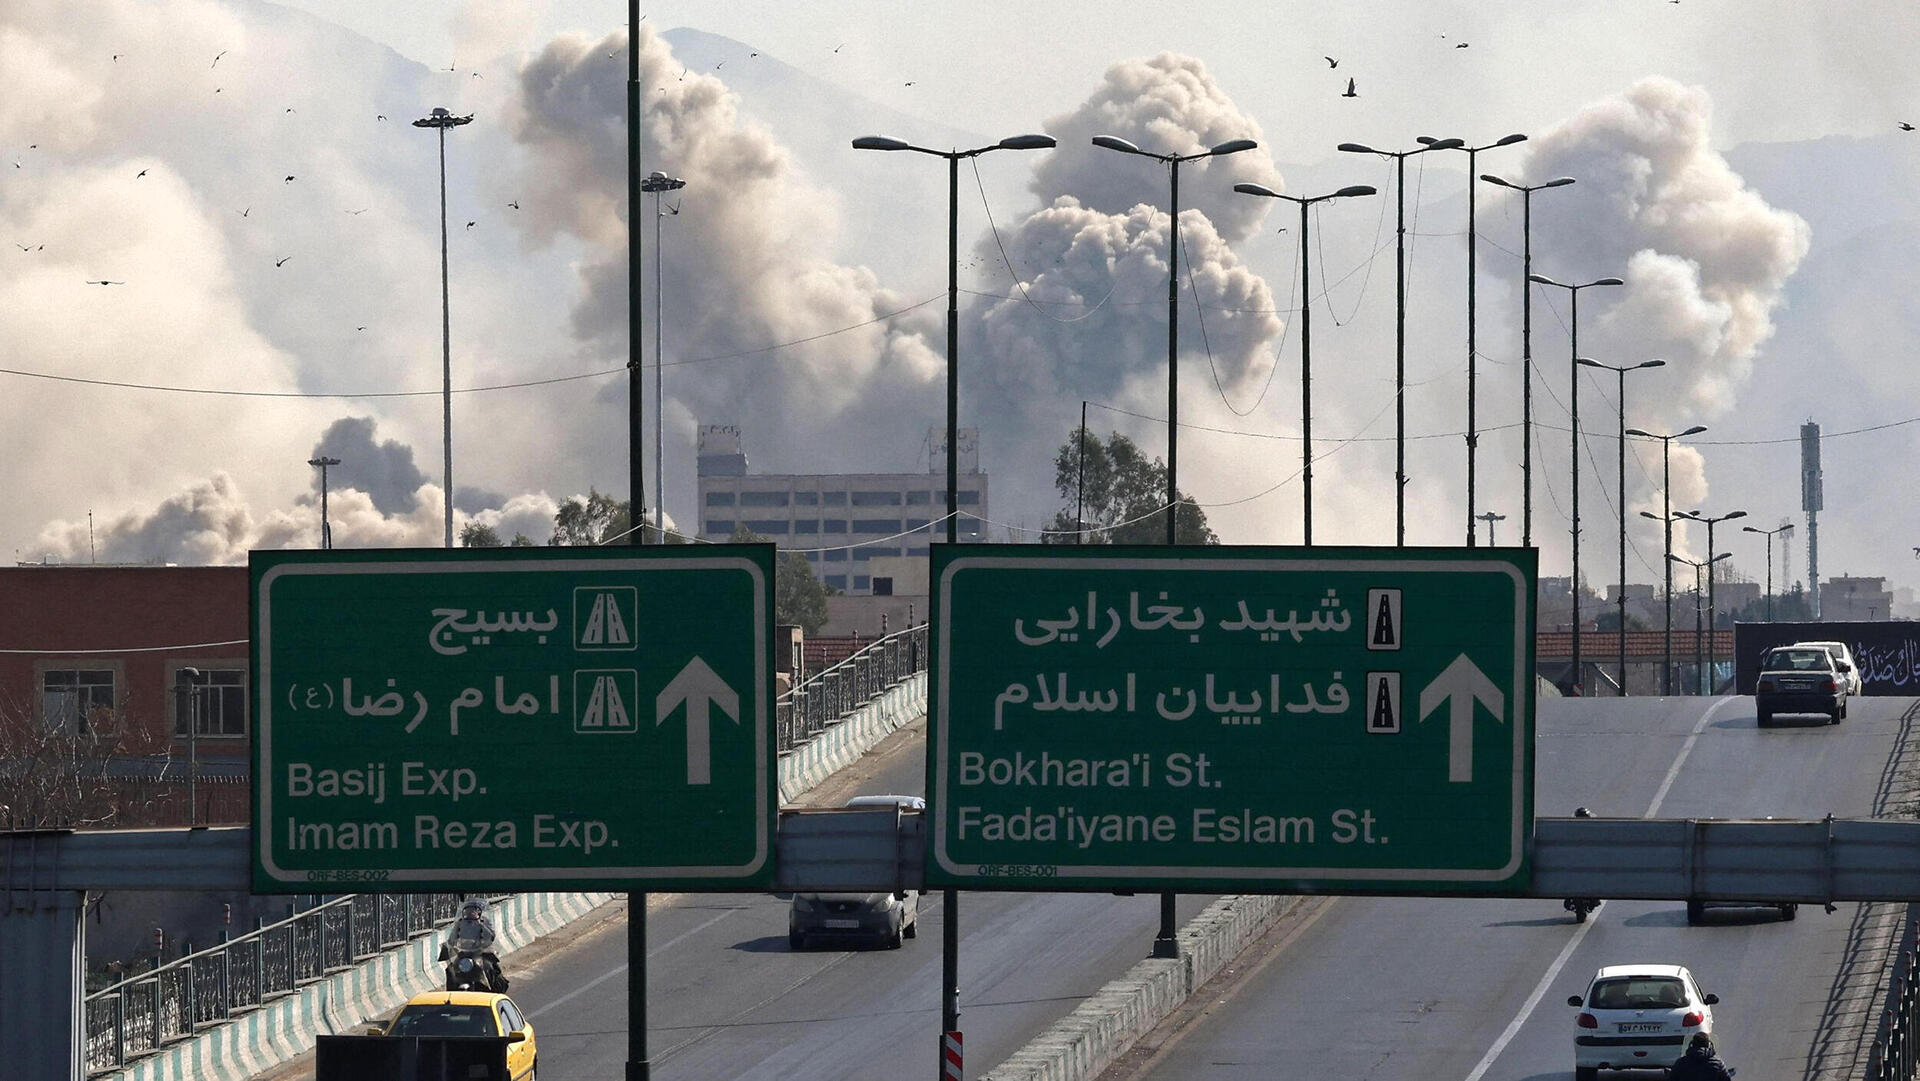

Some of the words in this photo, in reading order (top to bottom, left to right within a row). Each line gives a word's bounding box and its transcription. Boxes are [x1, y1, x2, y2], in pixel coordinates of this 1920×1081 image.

[428, 607, 558, 655] بسیج
[1014, 591, 1205, 649] بخارایی
[1218, 588, 1351, 643] شهید
[342, 677, 428, 734] رضا
[450, 675, 559, 735] امام
[994, 672, 1137, 731] اسلام
[1155, 671, 1350, 725] فداییان
[288, 762, 386, 803] Basij
[402, 762, 487, 801] Exp.
[960, 750, 1151, 788] Bokhara'i
[1165, 753, 1223, 788] St.
[288, 816, 399, 851] Imam
[414, 814, 517, 850] Reza
[533, 813, 619, 855] Exp.
[958, 806, 1177, 849] Fada'iyane
[1192, 808, 1315, 844] Eslam
[1330, 808, 1389, 845] St.
